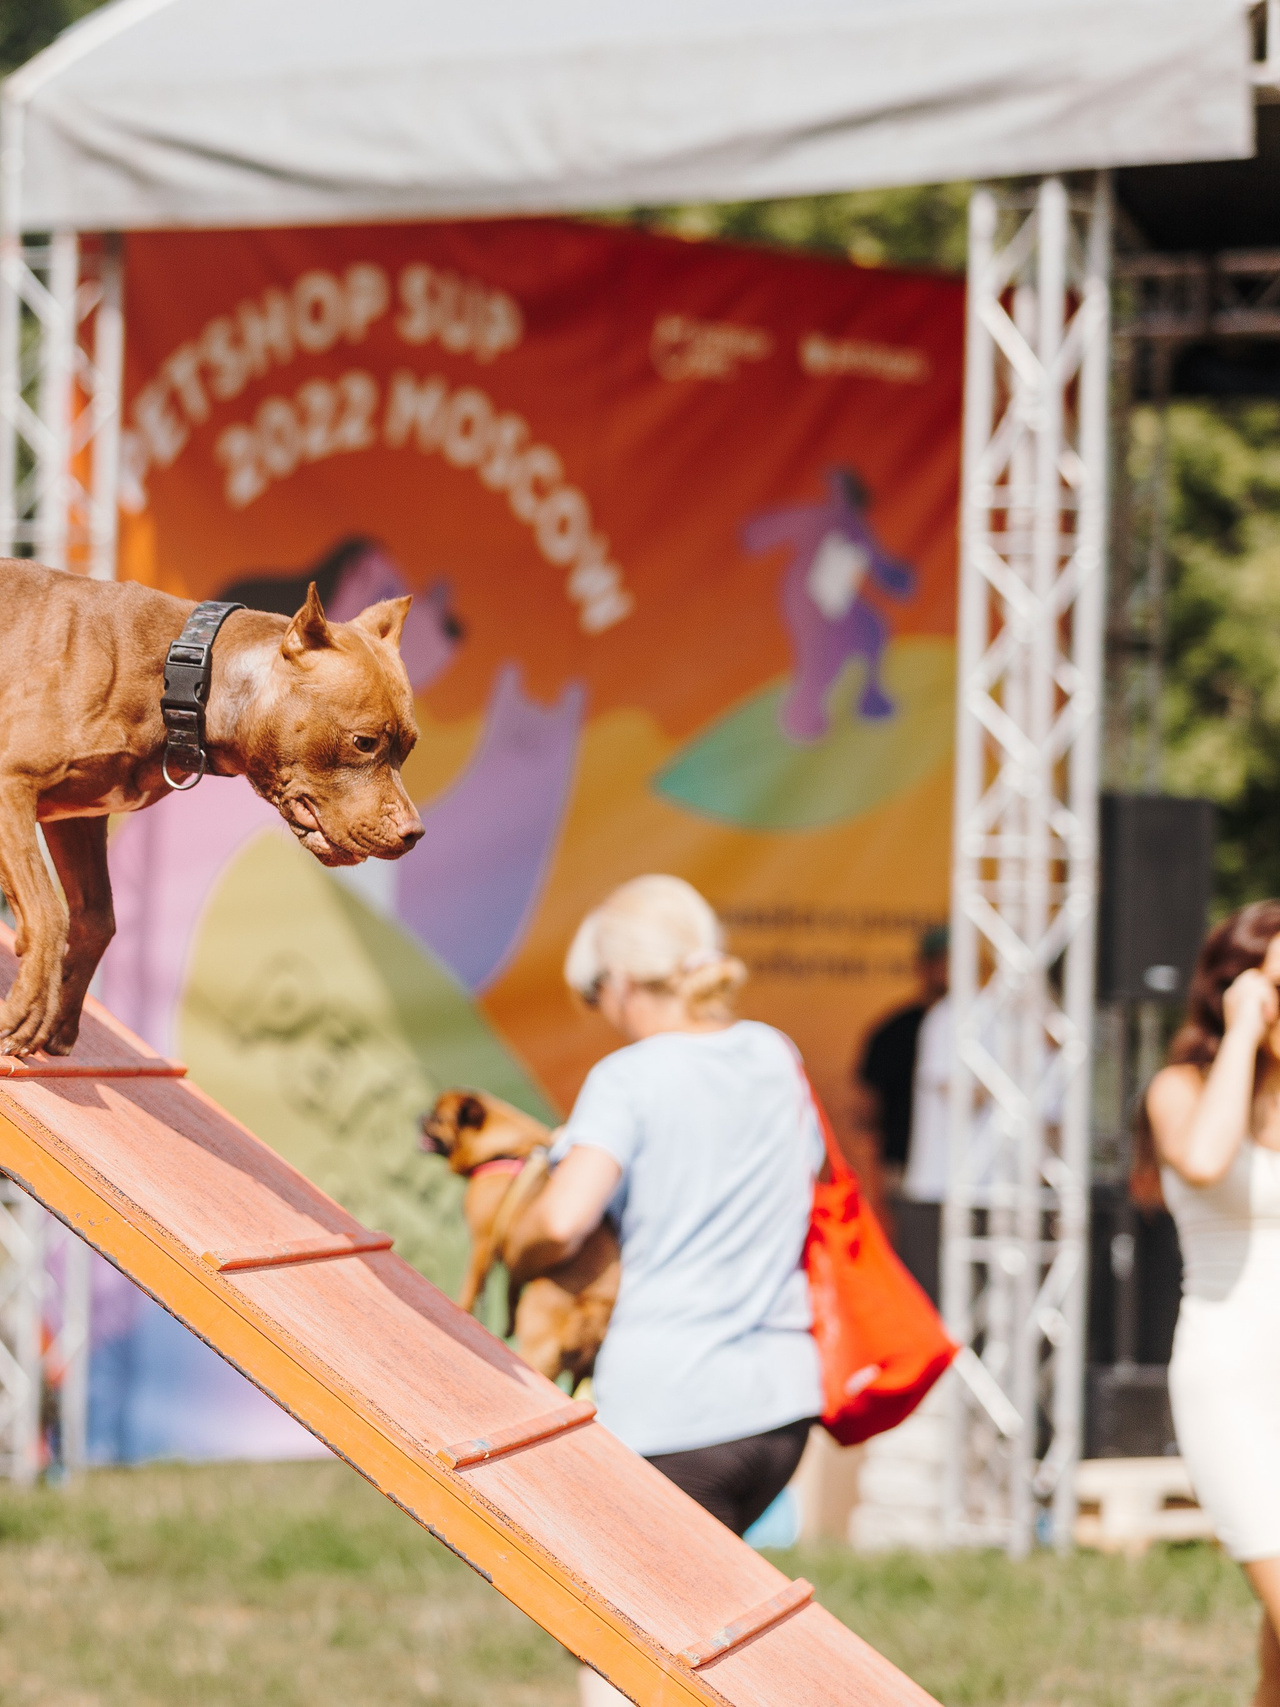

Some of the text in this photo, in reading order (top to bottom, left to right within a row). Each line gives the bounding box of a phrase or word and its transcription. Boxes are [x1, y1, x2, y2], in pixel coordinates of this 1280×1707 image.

[397, 263, 522, 362] SUP
[217, 368, 633, 634] 2022 MOSCOW
